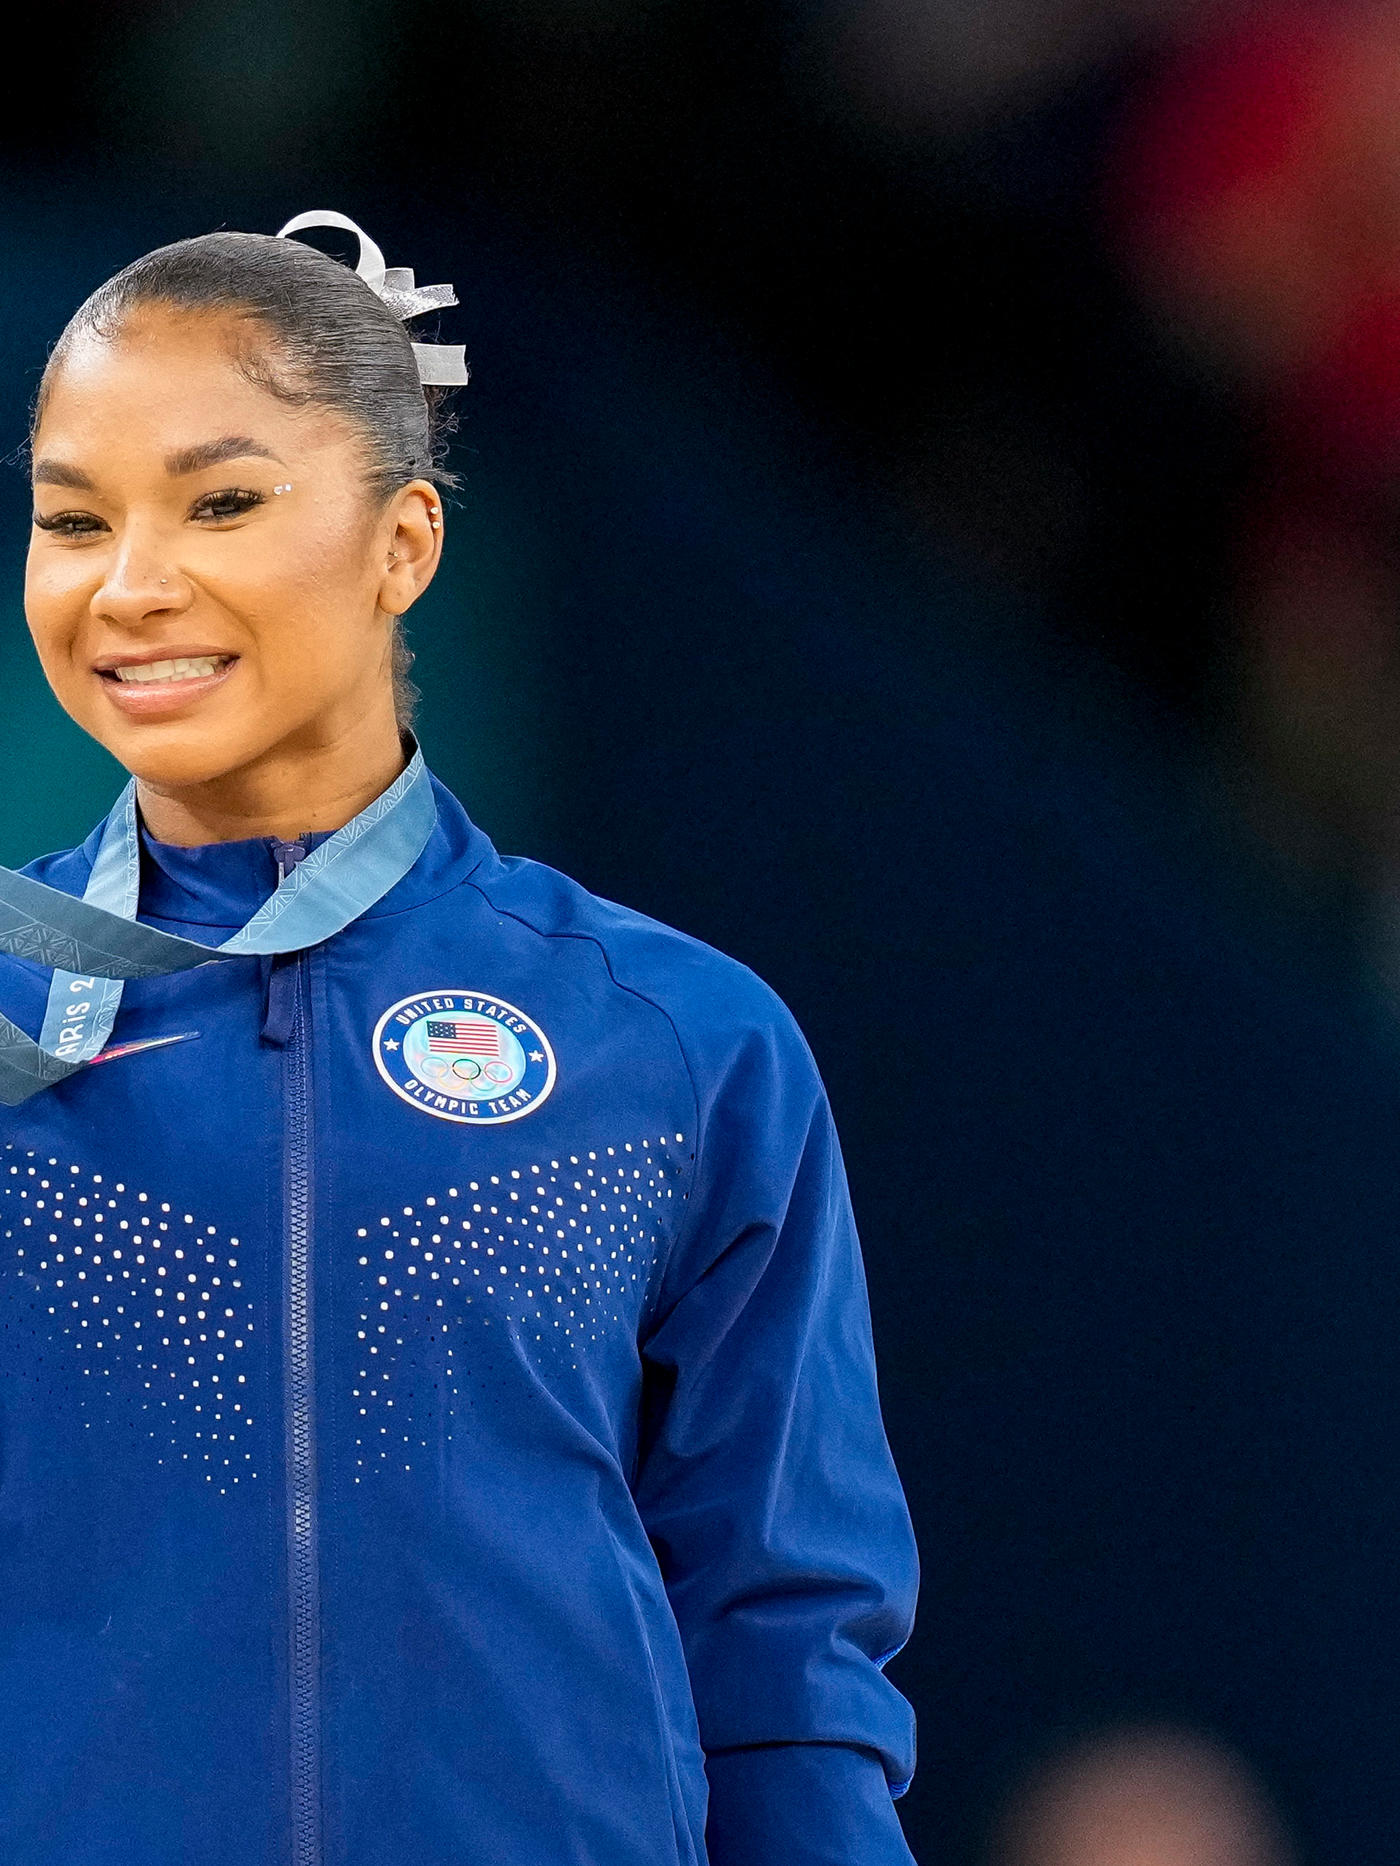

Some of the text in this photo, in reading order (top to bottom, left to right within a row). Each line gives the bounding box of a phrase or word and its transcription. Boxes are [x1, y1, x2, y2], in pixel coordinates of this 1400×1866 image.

[55, 1001, 91, 1056] ARiS
[395, 997, 527, 1033] UNITED STATES
[404, 1079, 532, 1115] OLYMPIC TEAM
